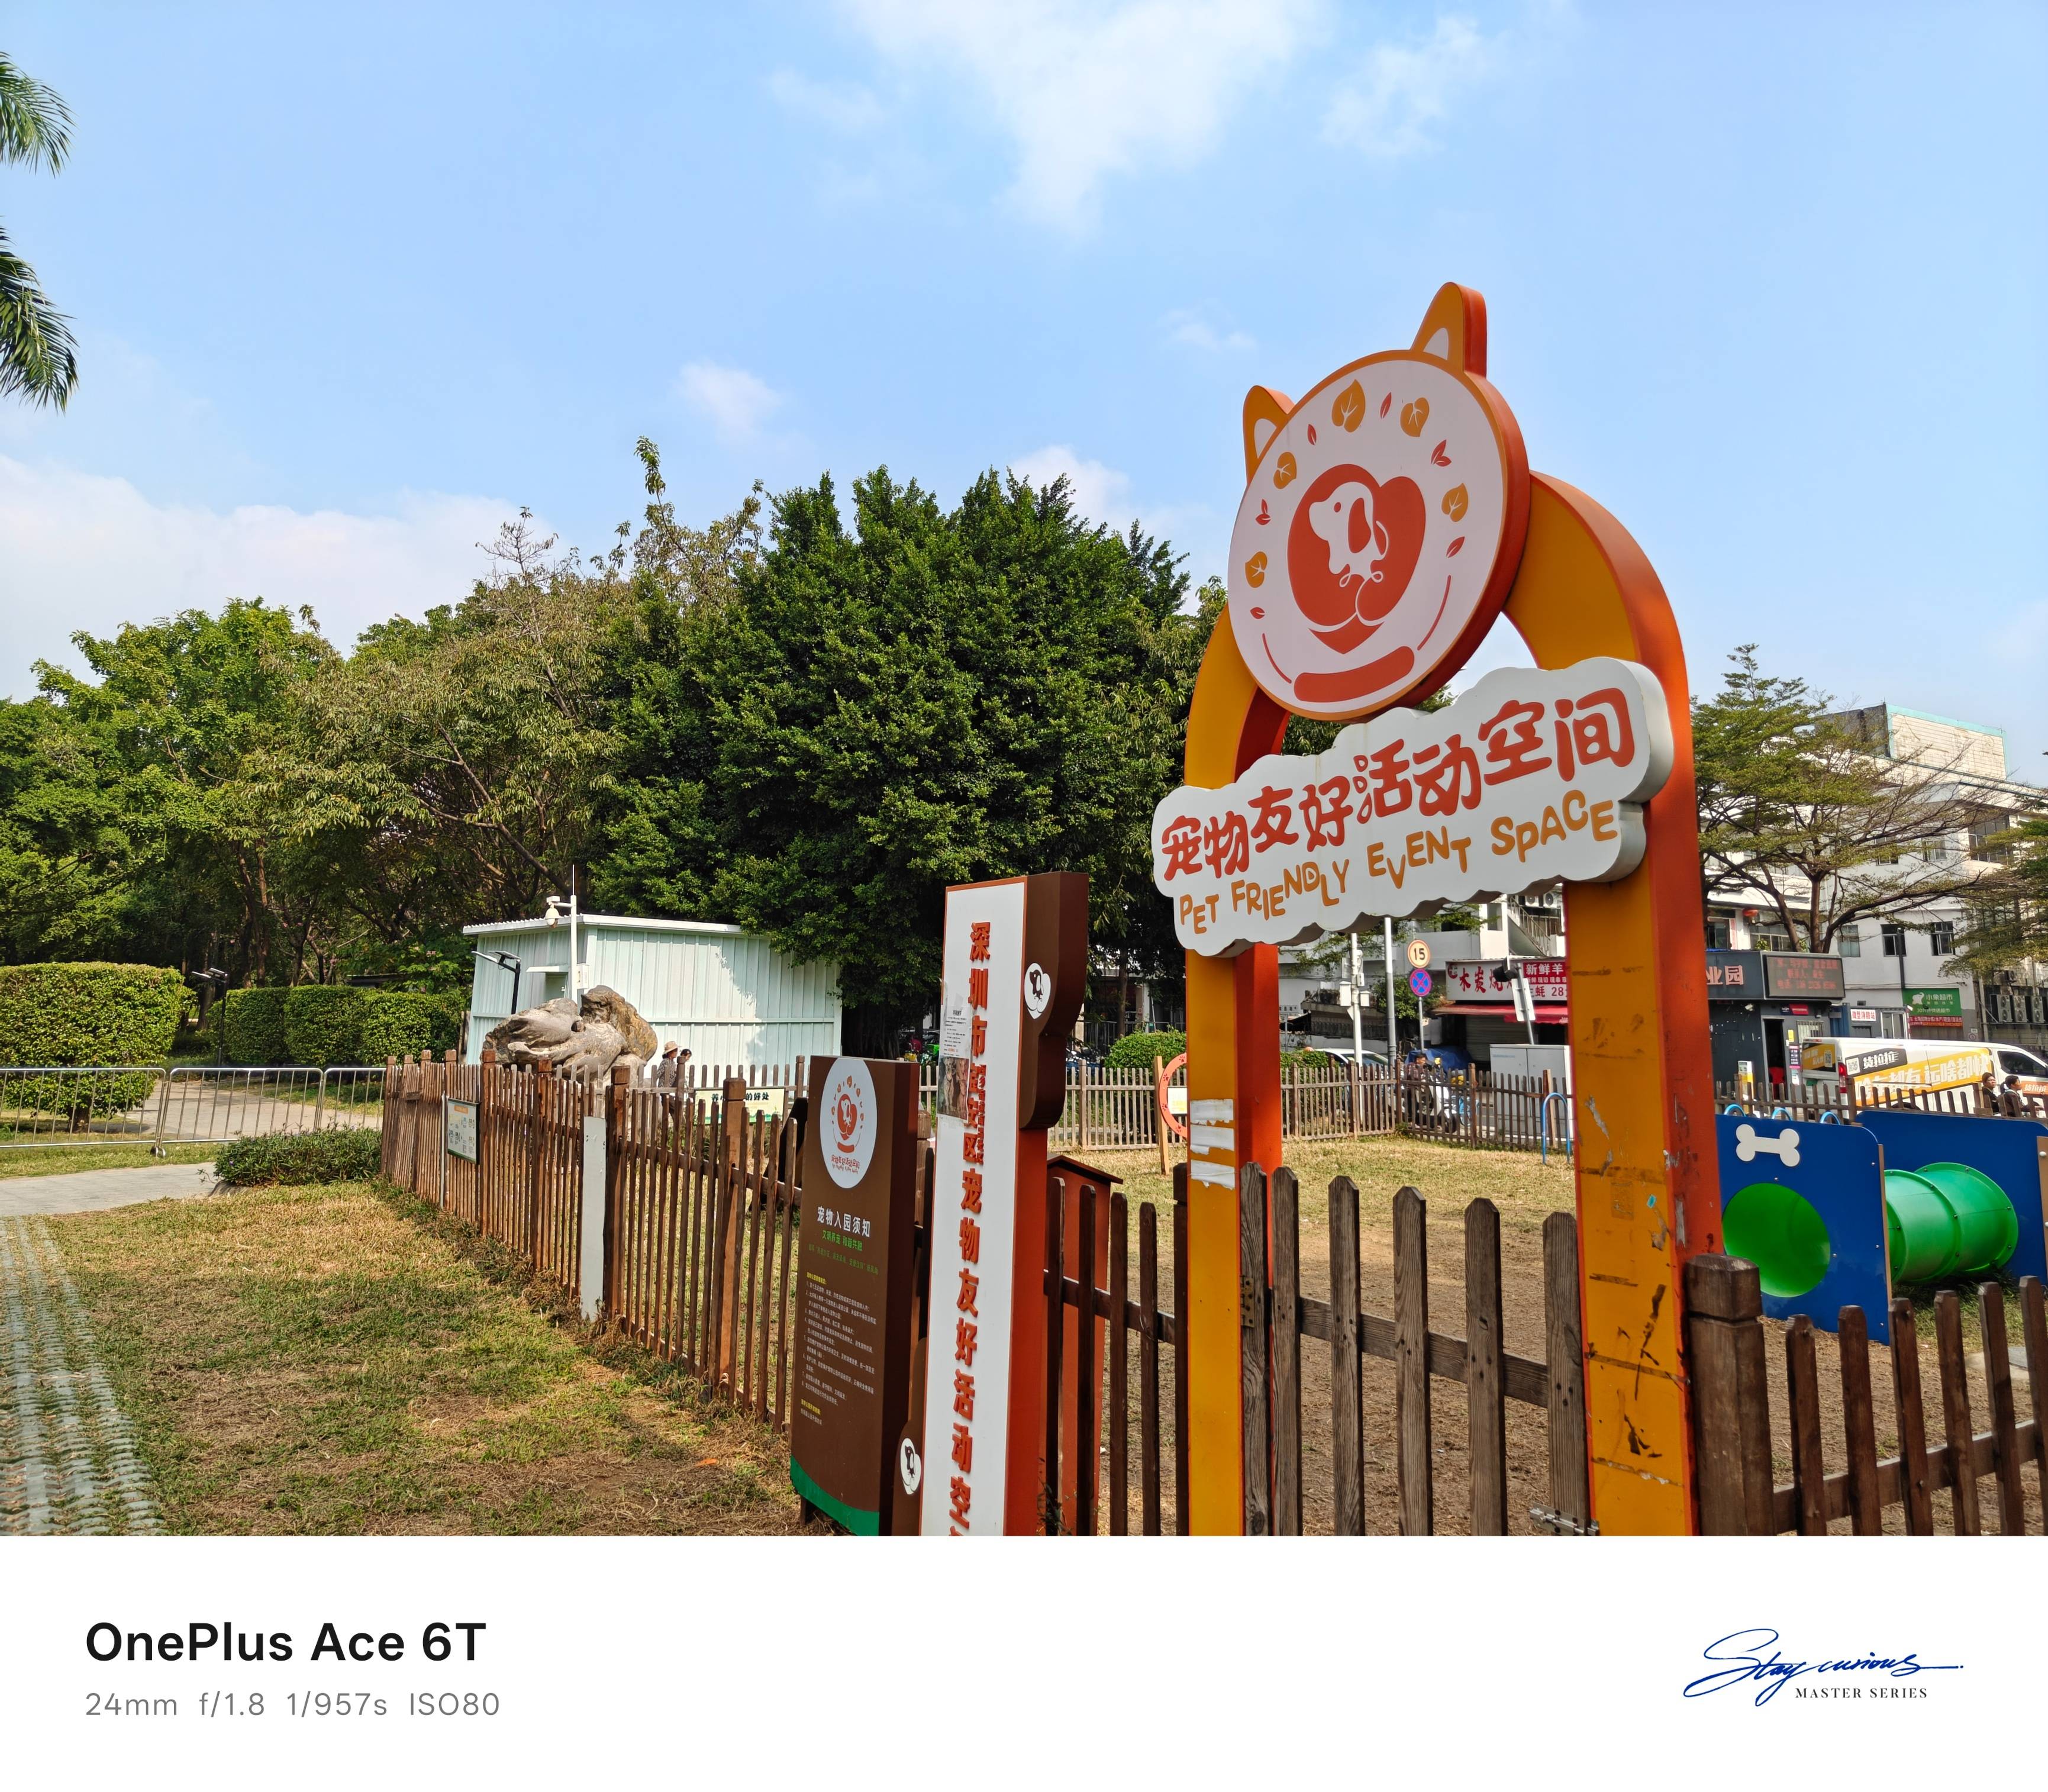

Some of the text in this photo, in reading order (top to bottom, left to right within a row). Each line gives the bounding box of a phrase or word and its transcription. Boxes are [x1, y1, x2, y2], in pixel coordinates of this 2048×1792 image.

[1162, 688, 1634, 881] 宠物友好活动空间
[1179, 789, 1618, 934] PET FRIENDLY EVENT SPACE
[1414, 947, 1426, 960] 15
[1459, 966, 1512, 993] 木炭烧
[1526, 963, 1563, 975] 新鲜羊
[1863, 1050, 1899, 1069] 货拉拉
[817, 1206, 870, 1237] 宠物入园须知
[949, 922, 991, 1536] 深圳市宝安区宠物友好活动空
